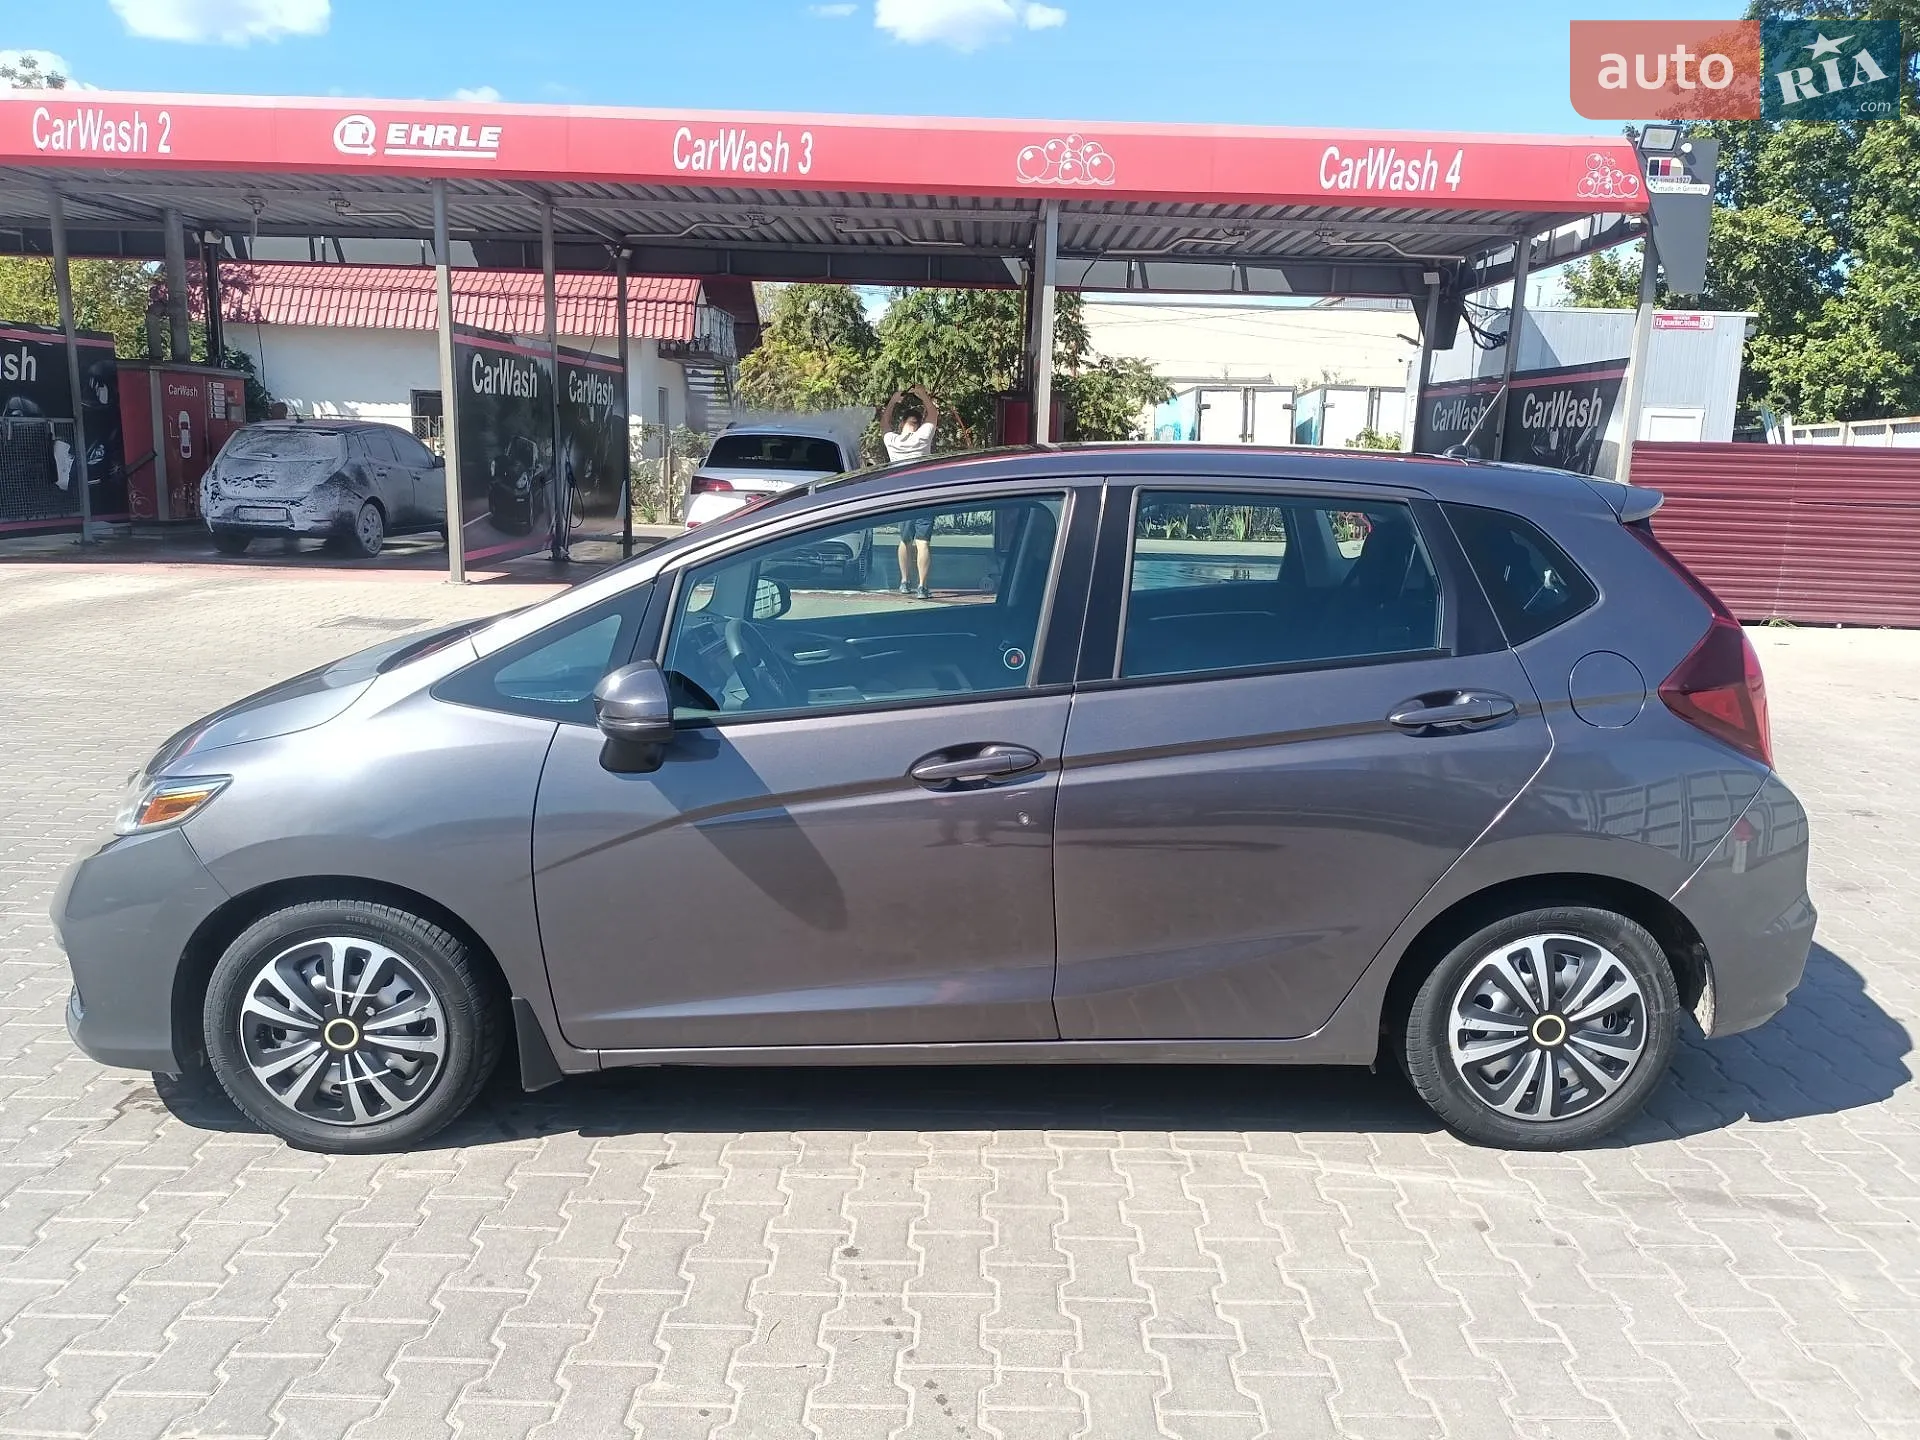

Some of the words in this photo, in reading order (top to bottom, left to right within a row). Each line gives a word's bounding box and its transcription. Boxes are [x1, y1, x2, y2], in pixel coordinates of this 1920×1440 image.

[32, 106, 148, 153] CarWash
[157, 110, 172, 153] 2
[385, 122, 503, 148] EHRLE
[673, 126, 790, 173] CarWash
[798, 131, 813, 175] 3
[1319, 146, 1439, 192] CarWash
[1445, 149, 1464, 192] 4
[168, 384, 198, 397] CarWash
[472, 353, 538, 398] CarWash
[568, 370, 614, 405] CarWash
[1432, 397, 1487, 431] CarWash
[1522, 387, 1603, 429] CarWash
